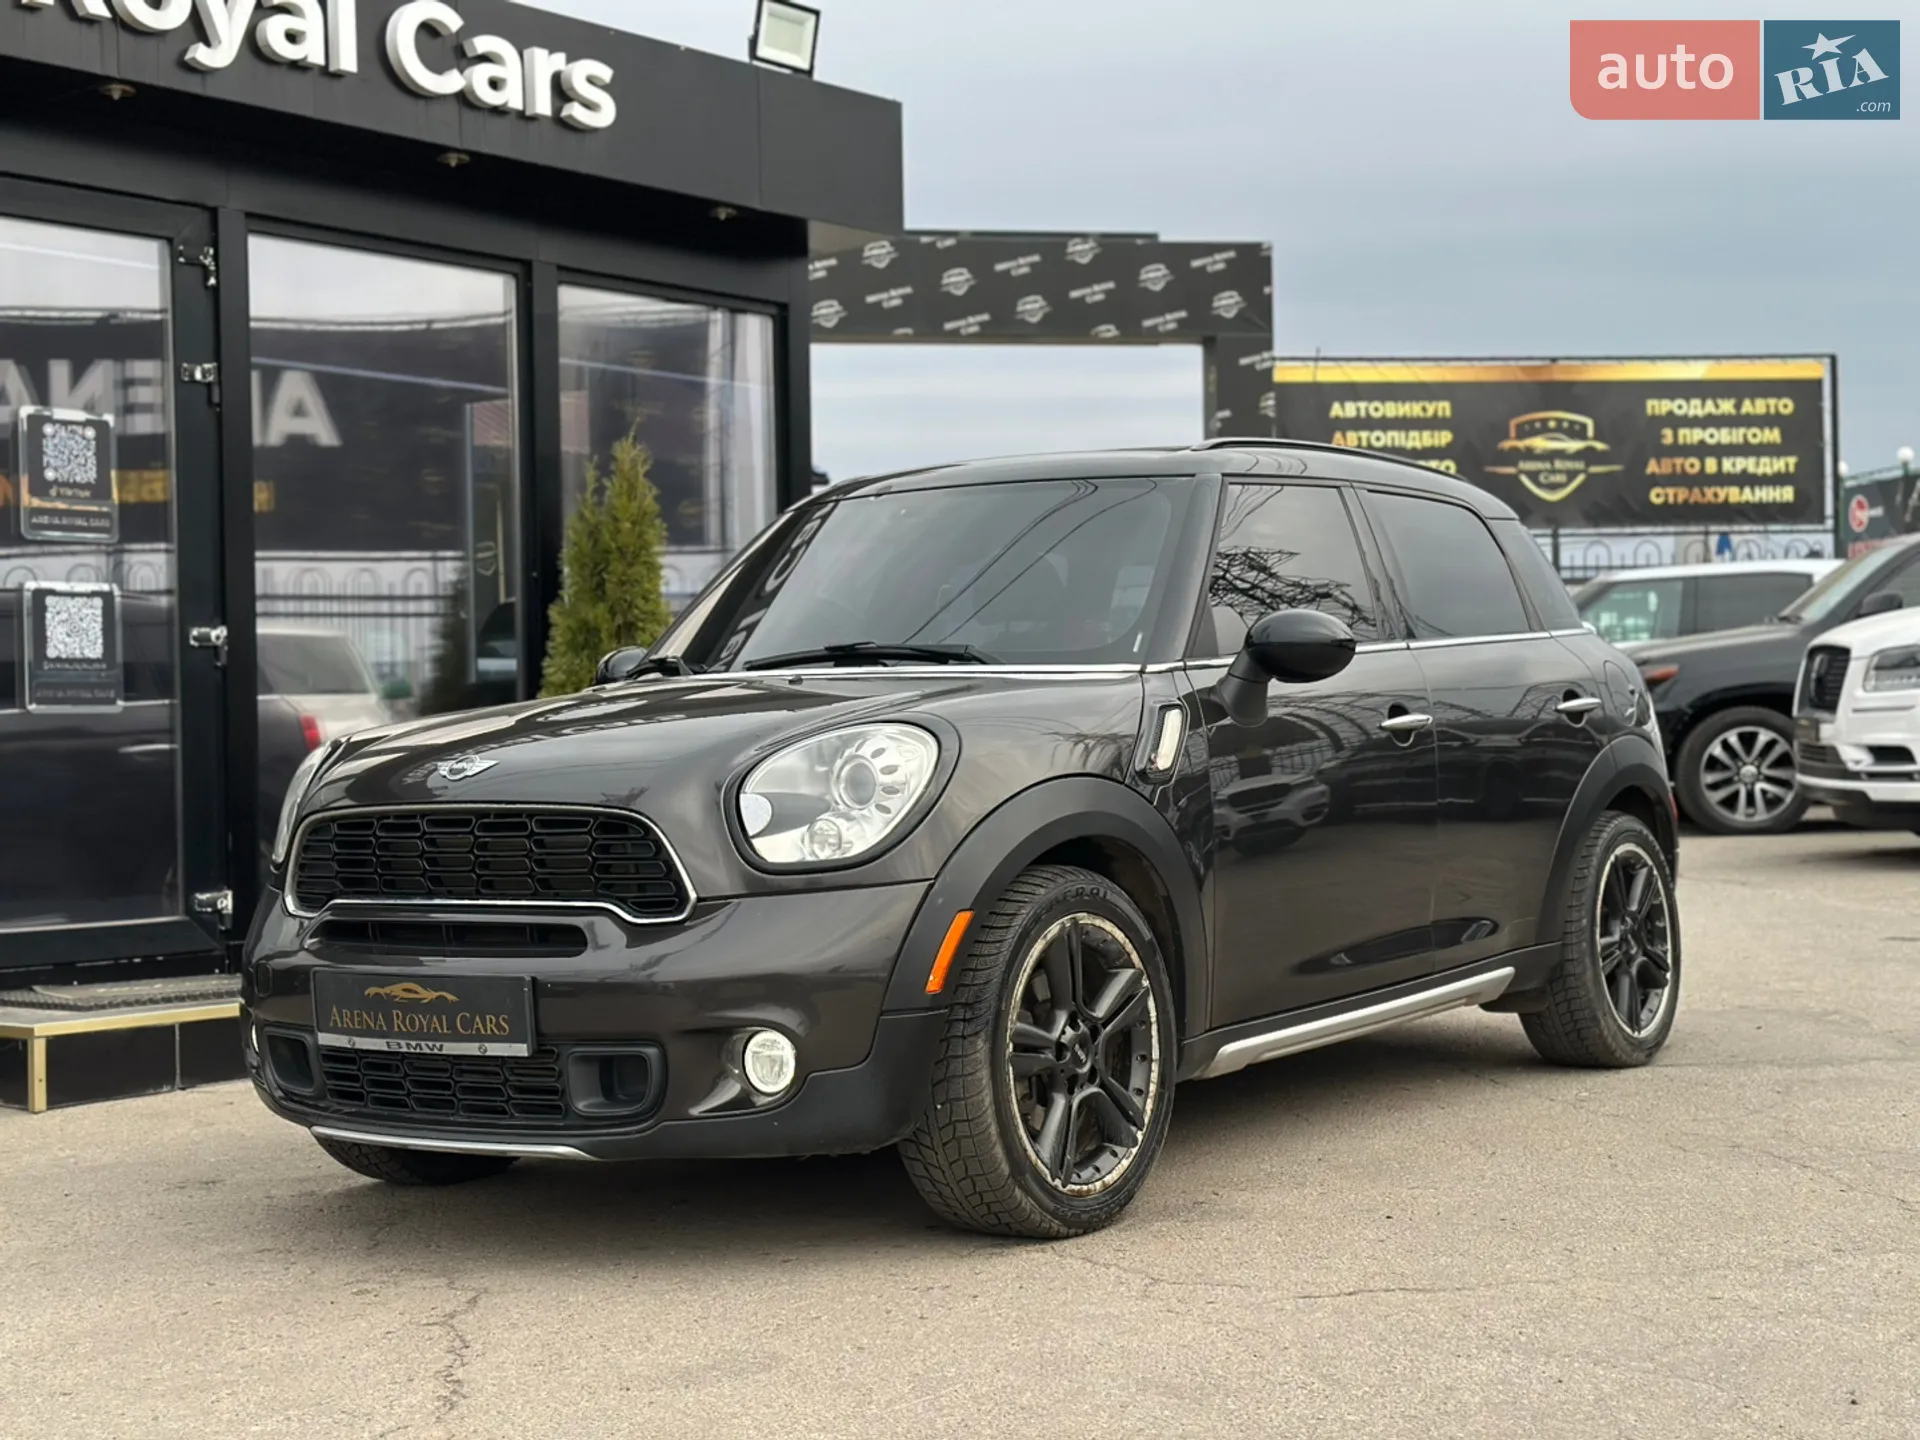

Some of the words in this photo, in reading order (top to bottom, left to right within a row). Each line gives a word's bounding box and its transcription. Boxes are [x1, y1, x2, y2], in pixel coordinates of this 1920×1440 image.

[20, 0, 358, 75] yal
[385, 0, 617, 131] Cars
[1329, 401, 1452, 418] АВТОВИКУП
[1646, 399, 1737, 417] ПРОДАЖ
[1740, 398, 1794, 415] АВТО
[1332, 431, 1454, 450] АВТОПІДБІР
[1677, 428, 1782, 445] ПРОБІГОМ
[1646, 457, 1701, 475] АВТО
[1704, 457, 1718, 474] В
[1721, 456, 1798, 475] КРЕДИТ
[1649, 487, 1795, 504] СТРАХУВАННЯ
[329, 1004, 388, 1031] ARENA
[392, 1009, 452, 1034] ROYAL
[456, 1012, 510, 1036] CARS
[385, 1041, 444, 1052] BMW
